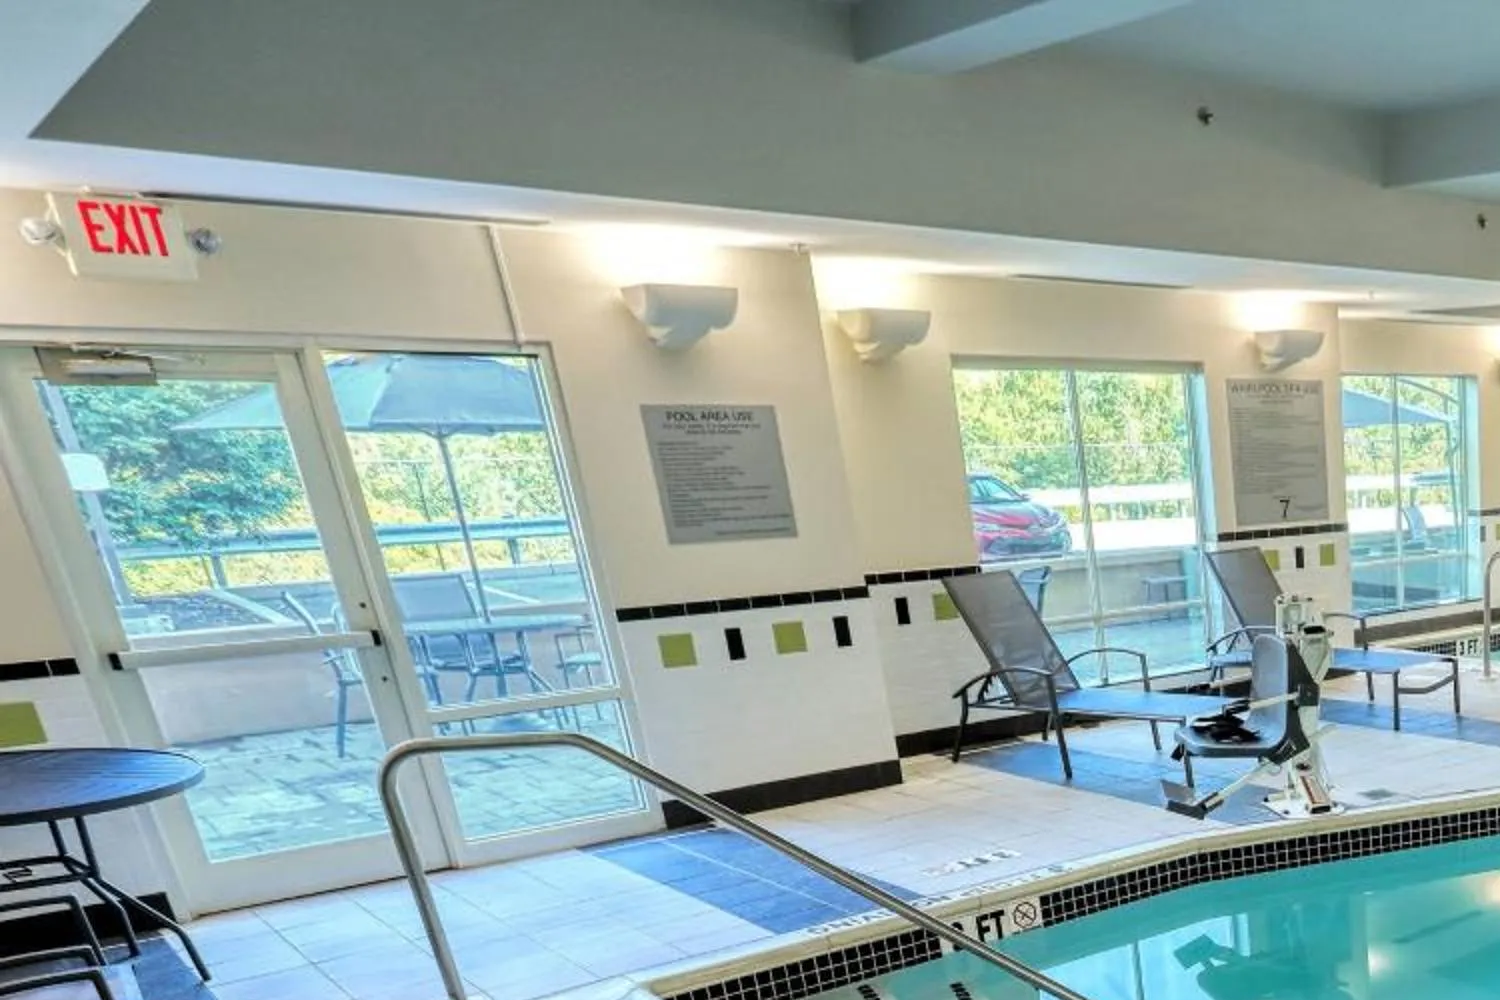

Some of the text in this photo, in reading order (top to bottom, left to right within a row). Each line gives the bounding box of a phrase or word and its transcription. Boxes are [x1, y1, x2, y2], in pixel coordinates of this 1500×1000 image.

[77, 200, 169, 257] EXIT
[665, 411, 697, 421] POOL
[700, 410, 729, 421] AREA
[1279, 499, 1290, 518] 7
[1467, 639, 1478, 654] FT
[976, 910, 1004, 942] FT
